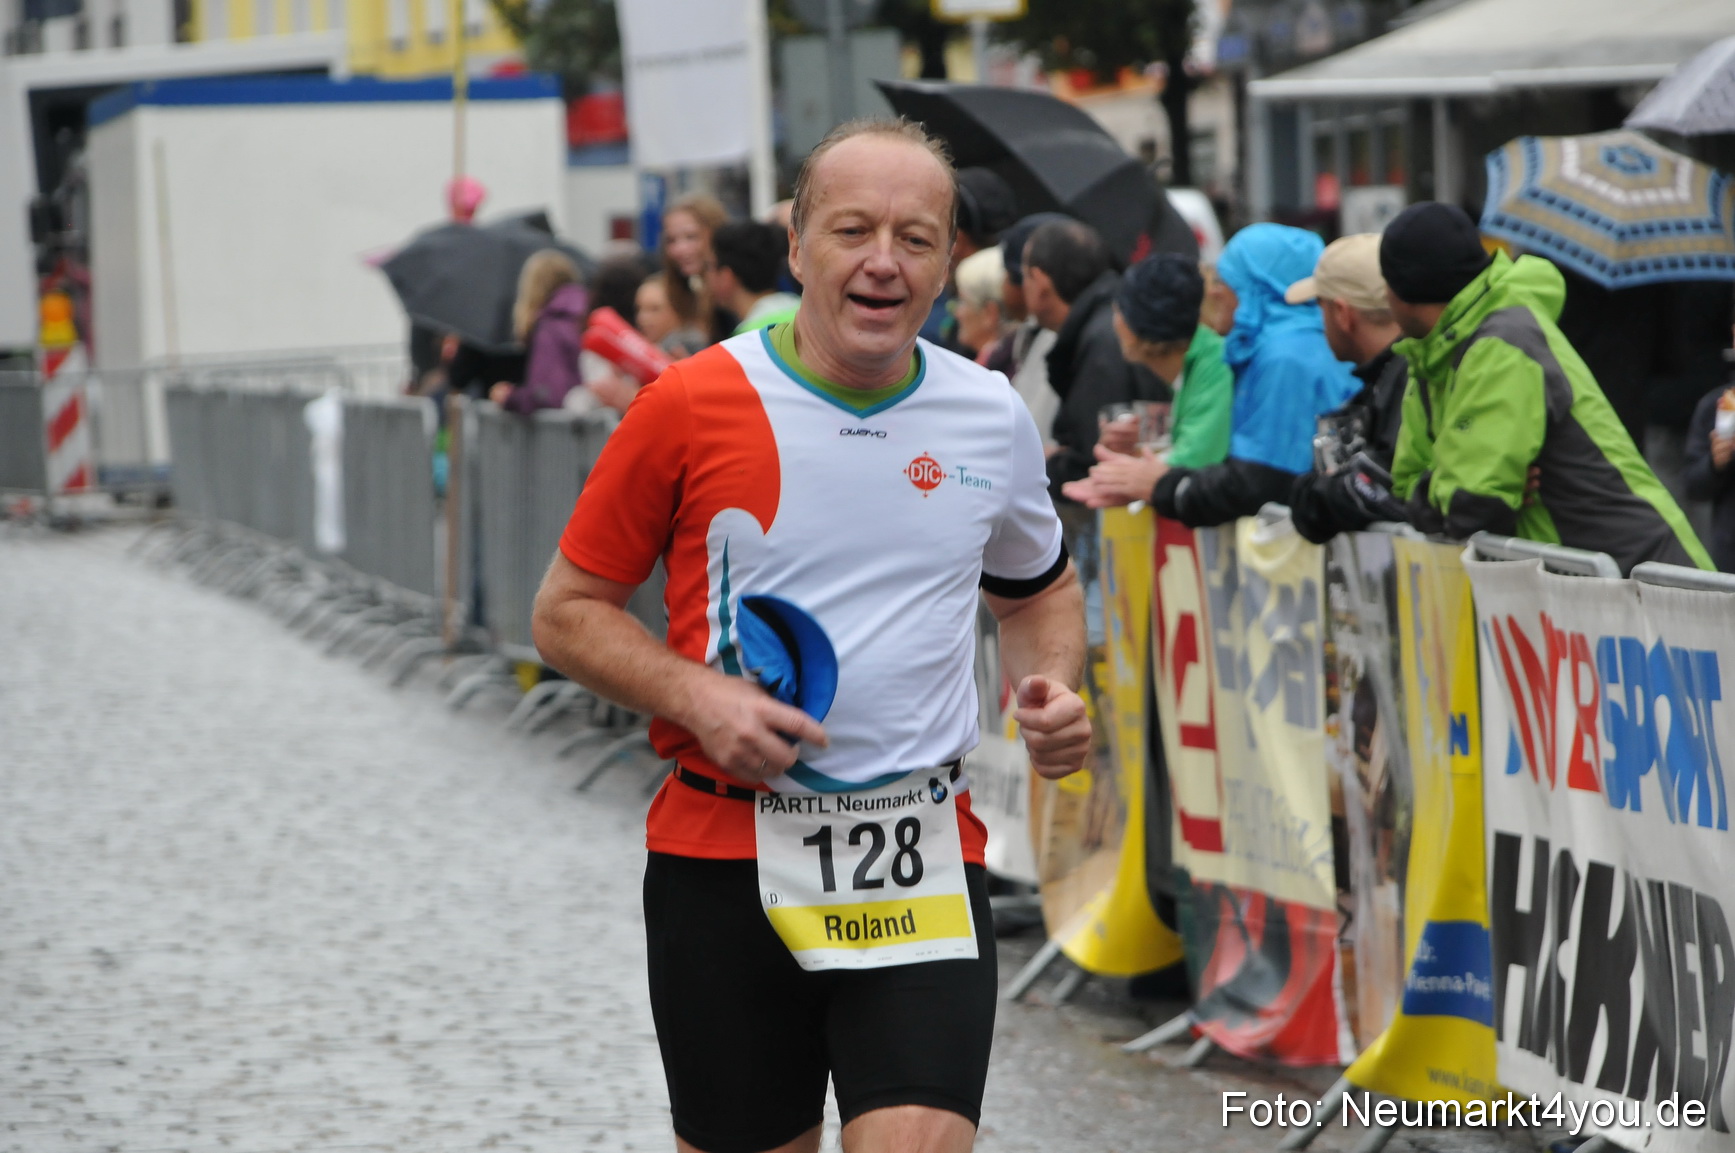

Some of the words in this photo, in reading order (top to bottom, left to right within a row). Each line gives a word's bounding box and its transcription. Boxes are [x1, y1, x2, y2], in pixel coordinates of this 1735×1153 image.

[839, 428, 888, 439] owayo
[910, 460, 942, 484] DTC
[836, 788, 926, 813] Neumarkt
[803, 816, 924, 893] 128
[769, 893, 779, 905] D
[824, 908, 917, 942] Roland
[1491, 830, 1735, 1134] HCKNER
